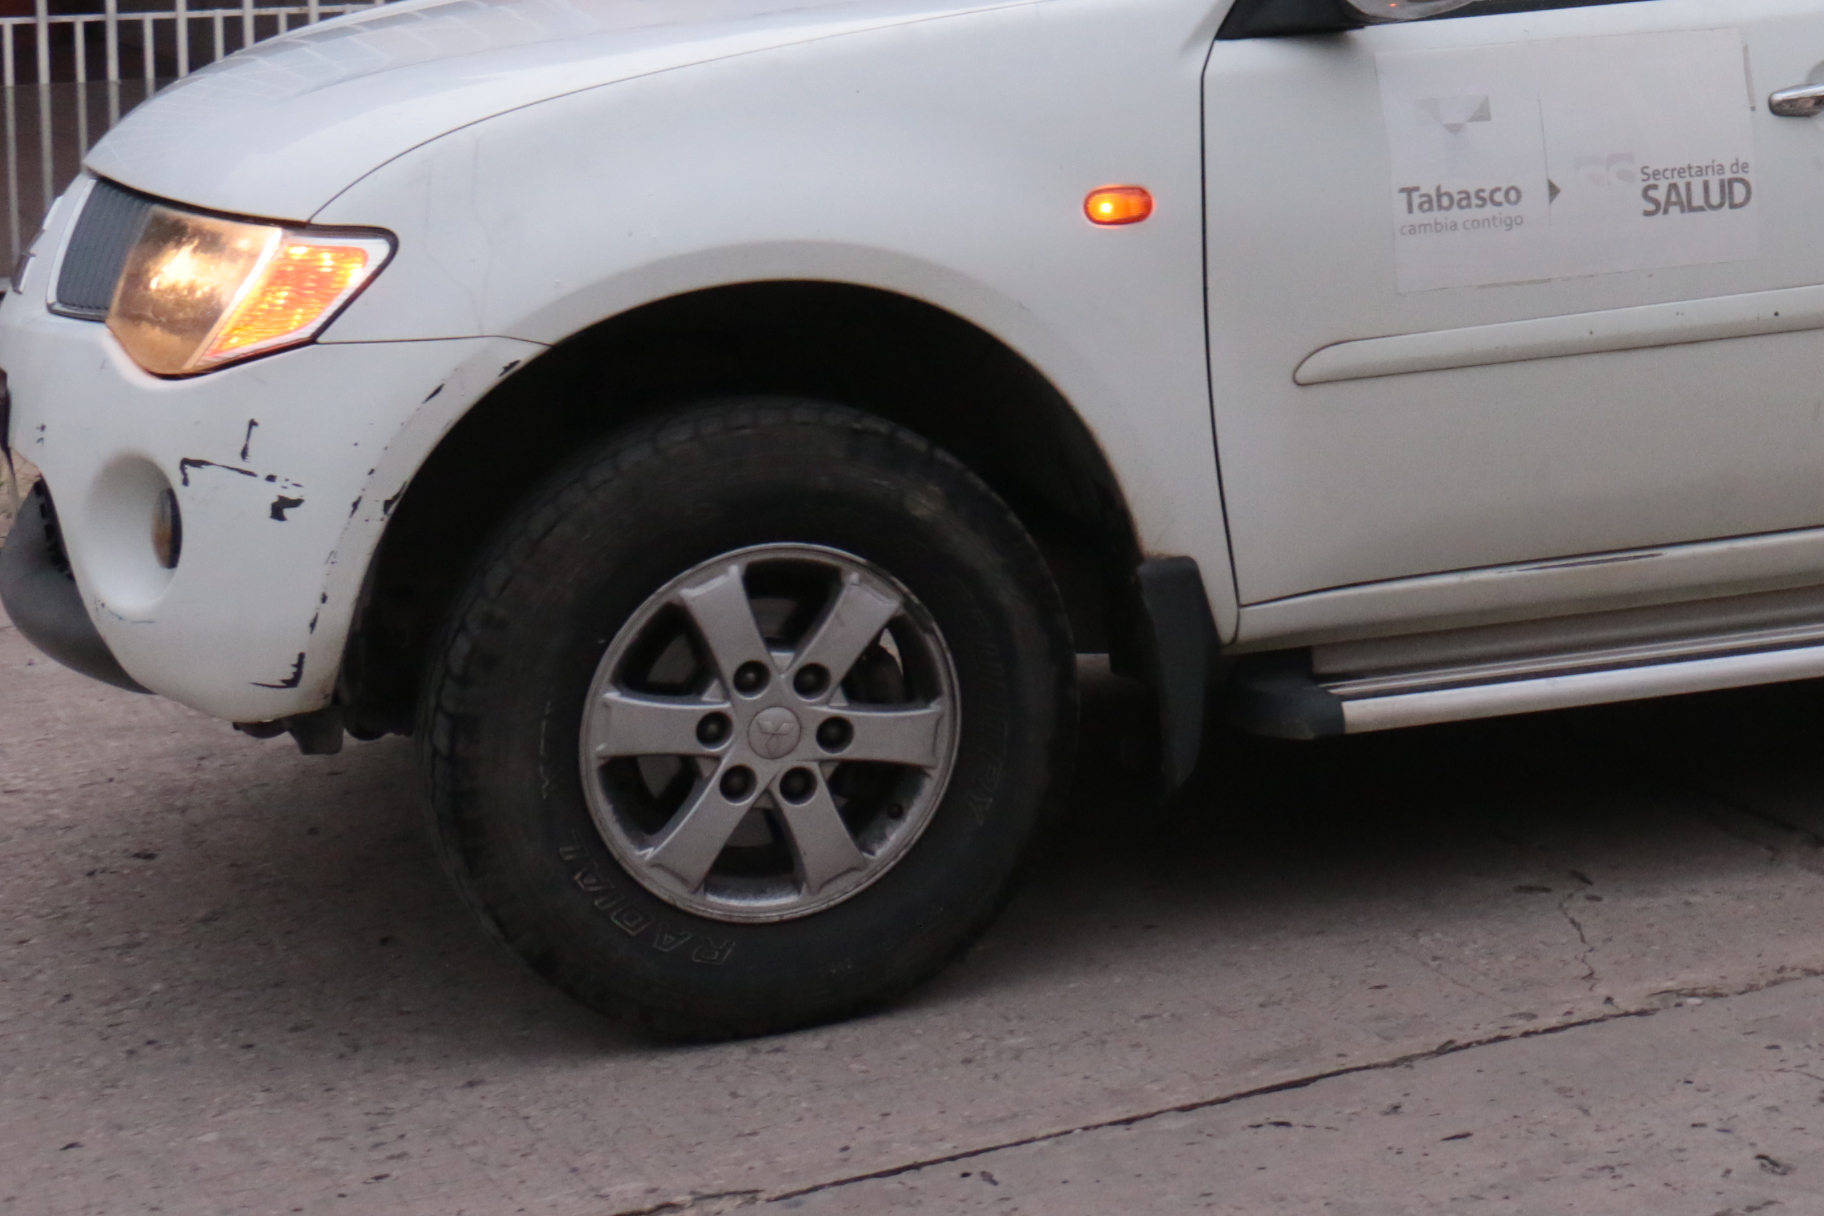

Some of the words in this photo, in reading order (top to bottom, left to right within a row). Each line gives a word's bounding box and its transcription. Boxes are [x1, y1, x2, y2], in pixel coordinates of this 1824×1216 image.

[1640, 159, 1725, 182] Secretaría
[1730, 157, 1750, 175] de
[1398, 184, 1523, 215] Tabasco
[1641, 177, 1752, 217] SALUD
[1400, 218, 1458, 236] cambia
[1462, 212, 1524, 232] contigo
[558, 830, 737, 966] RADIAL
